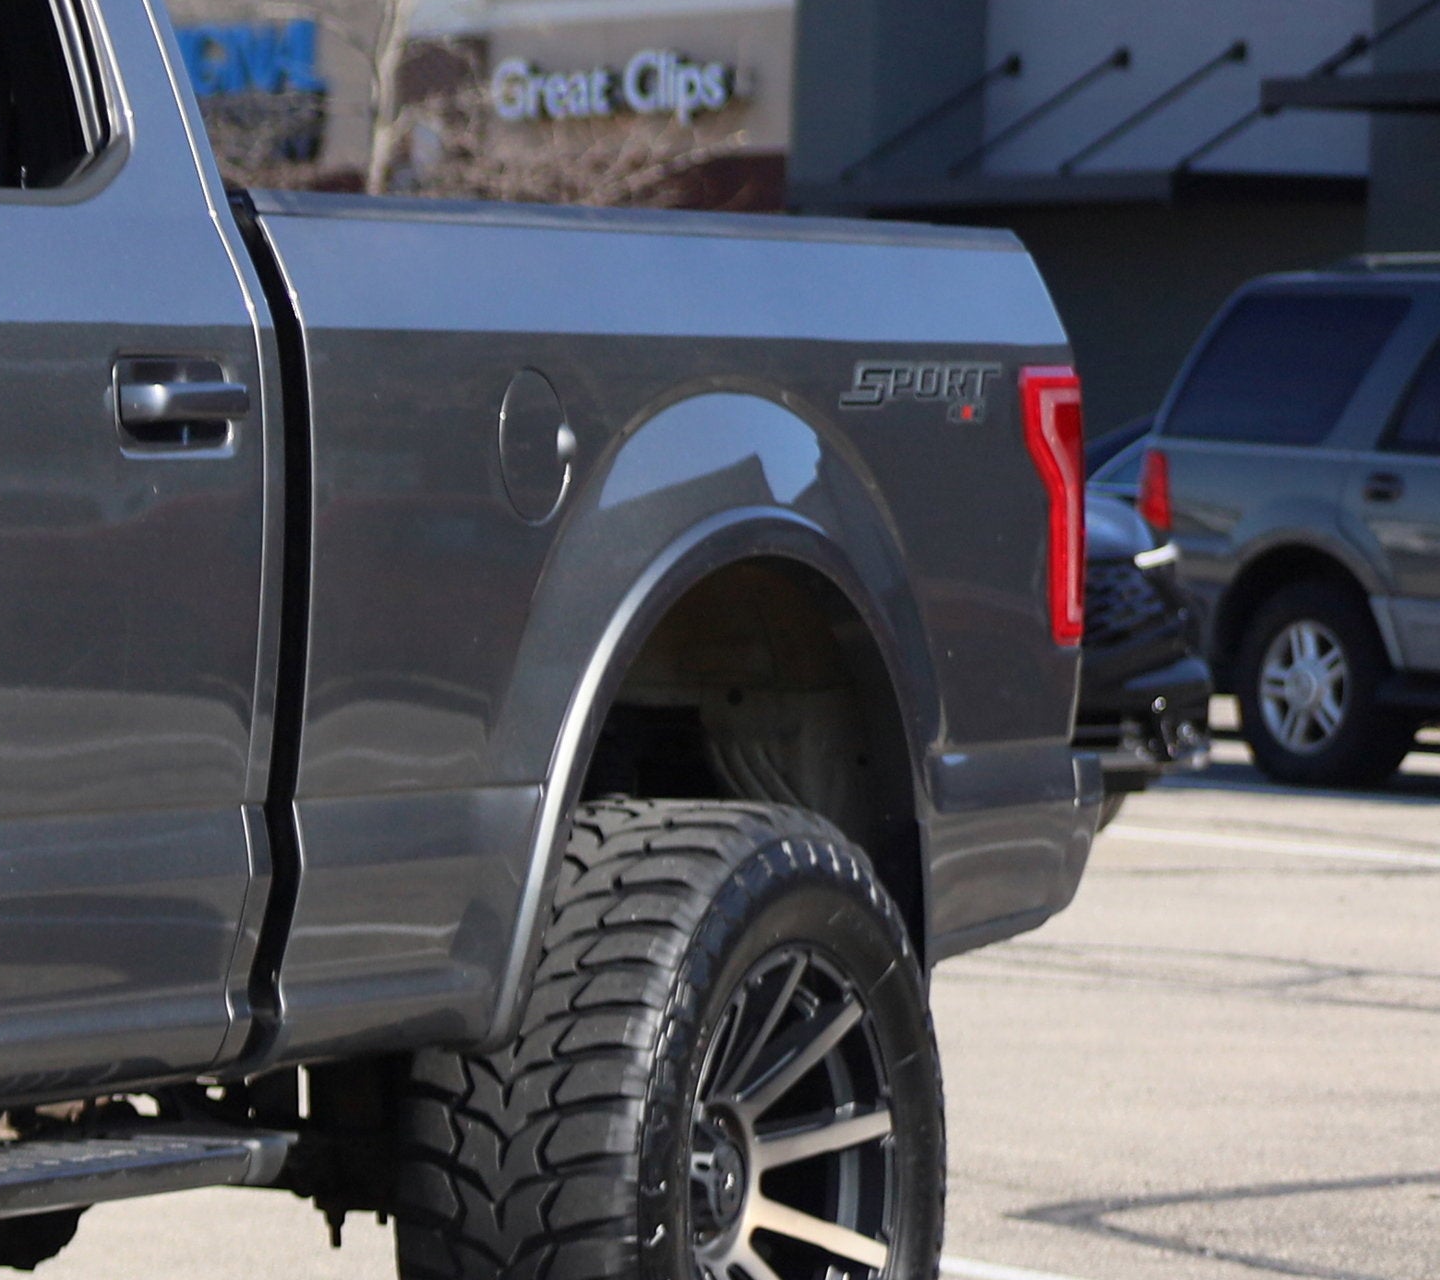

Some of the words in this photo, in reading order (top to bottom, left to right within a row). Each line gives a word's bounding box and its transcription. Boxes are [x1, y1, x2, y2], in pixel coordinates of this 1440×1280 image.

[494, 58, 606, 117] Great
[624, 51, 724, 124] Clips
[838, 360, 1002, 409] SPORT
